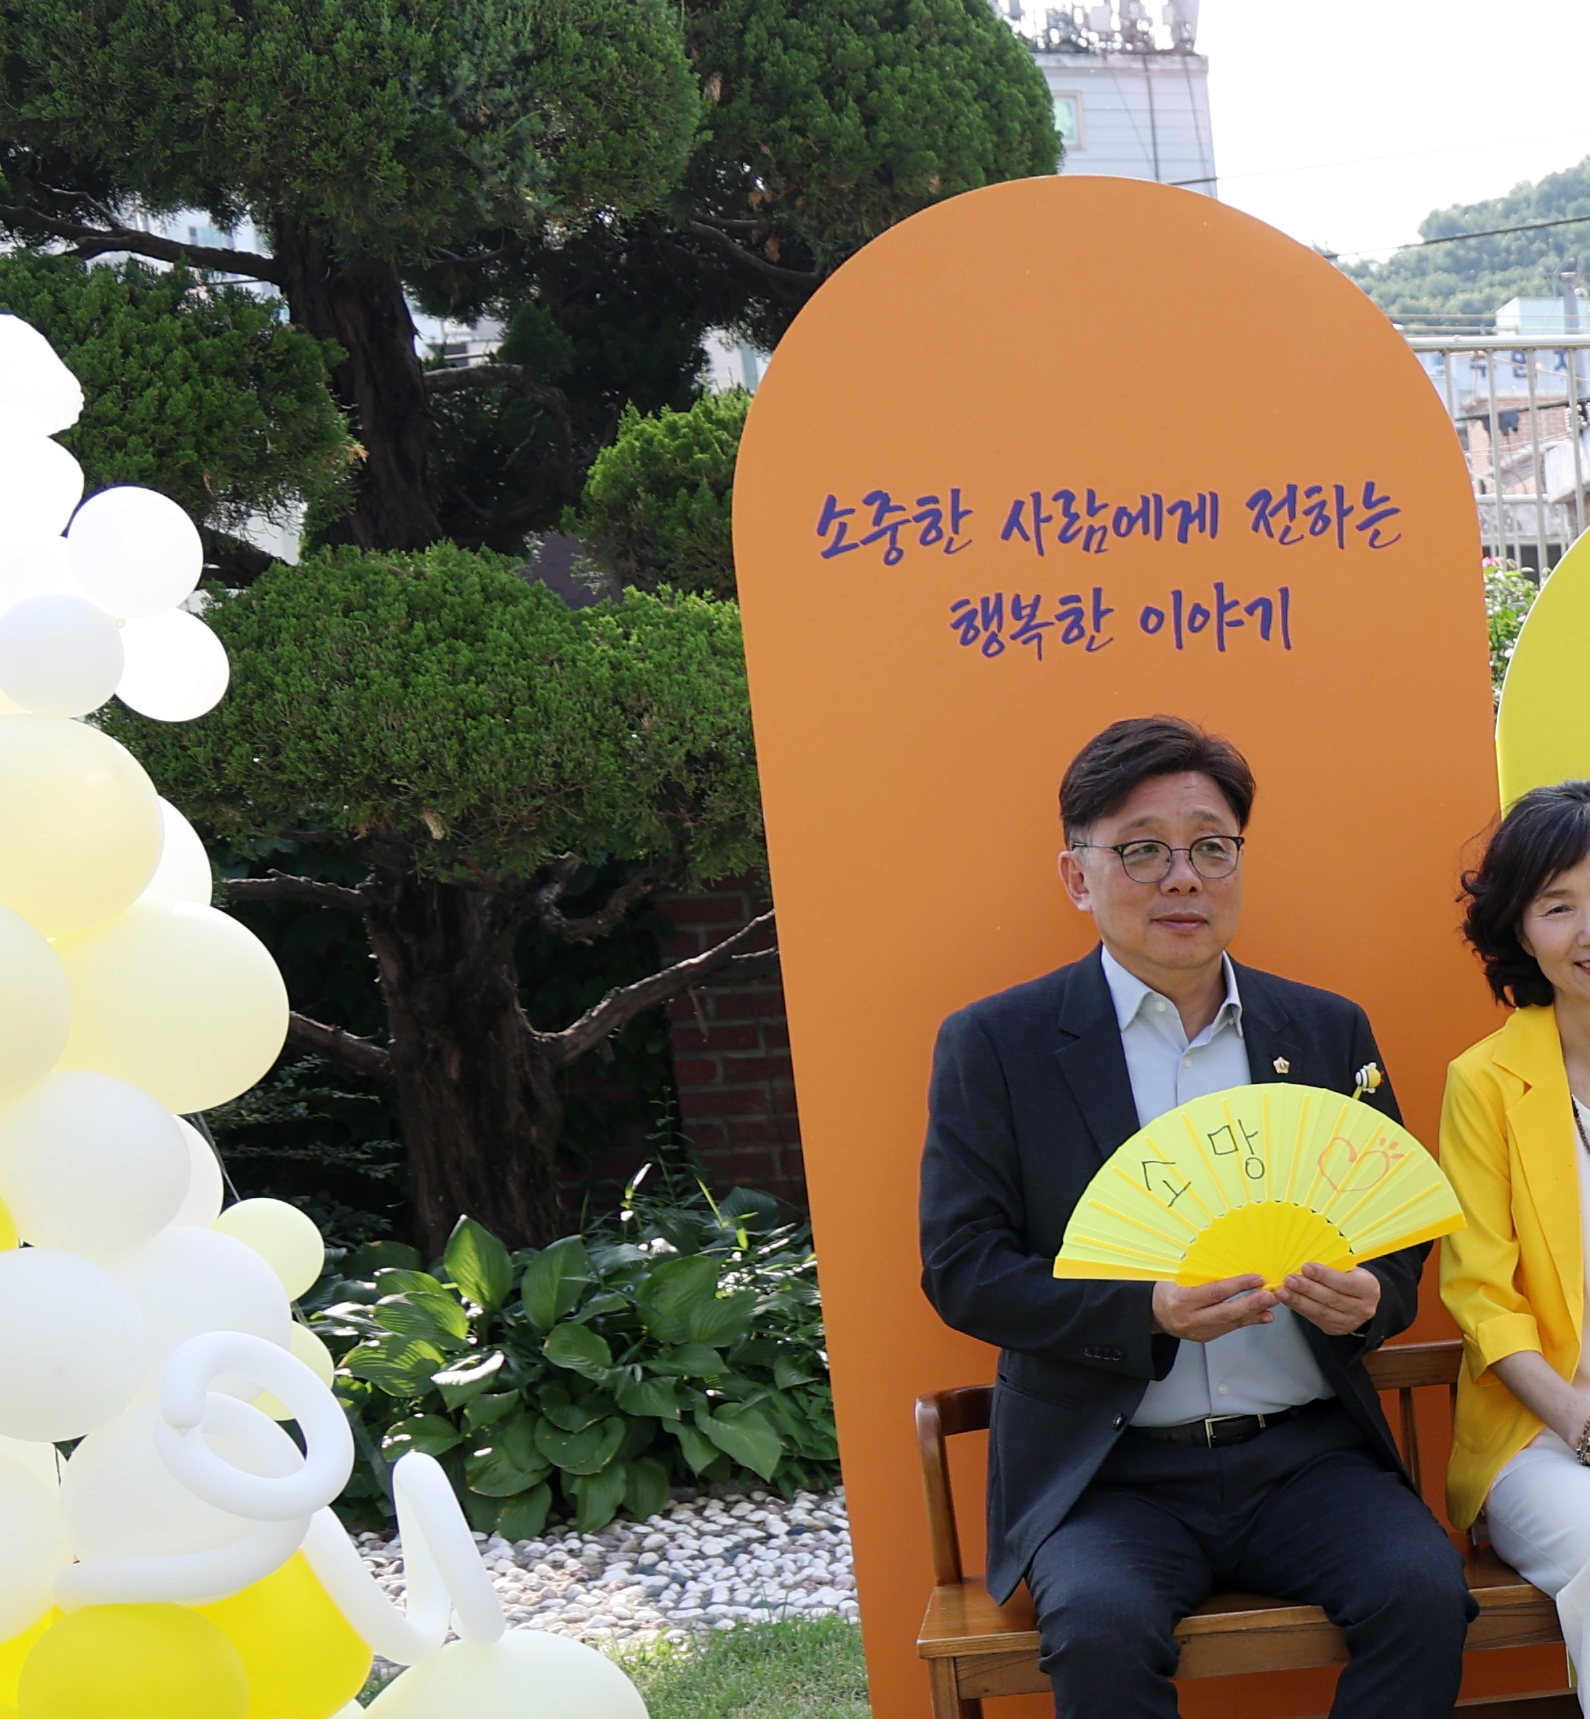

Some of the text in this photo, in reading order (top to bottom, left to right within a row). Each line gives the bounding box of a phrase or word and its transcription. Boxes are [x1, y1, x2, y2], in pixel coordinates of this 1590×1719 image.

[818, 482, 1401, 565] 소중한 사람에게 전하는
[951, 583, 1291, 660] 행복한 이야기
